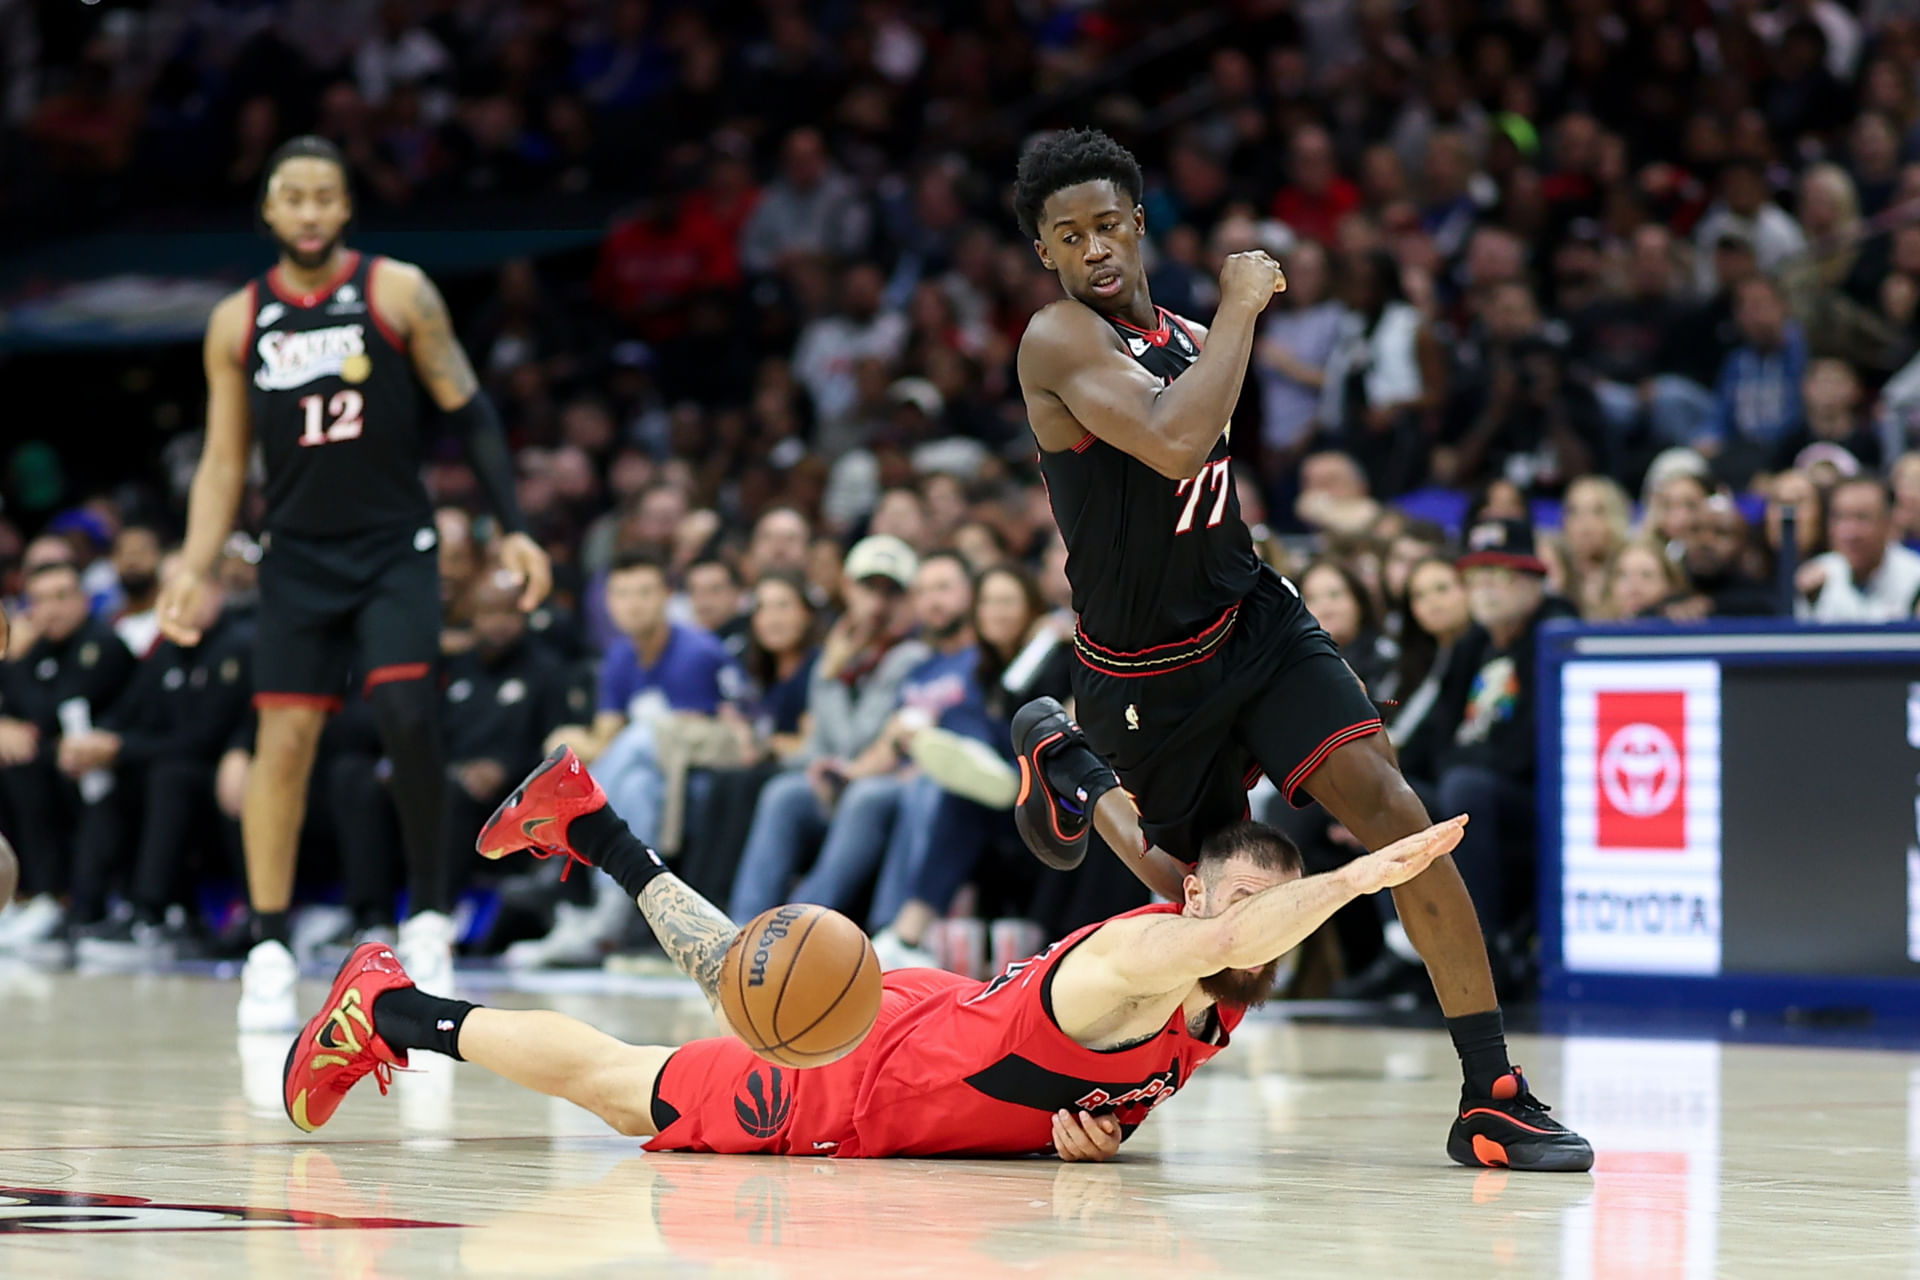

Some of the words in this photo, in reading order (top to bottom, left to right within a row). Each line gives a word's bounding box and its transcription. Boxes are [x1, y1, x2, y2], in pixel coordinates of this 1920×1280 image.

[299, 389, 365, 447] 12
[1174, 456, 1232, 536] 77
[1573, 890, 1707, 936] TOYOTA
